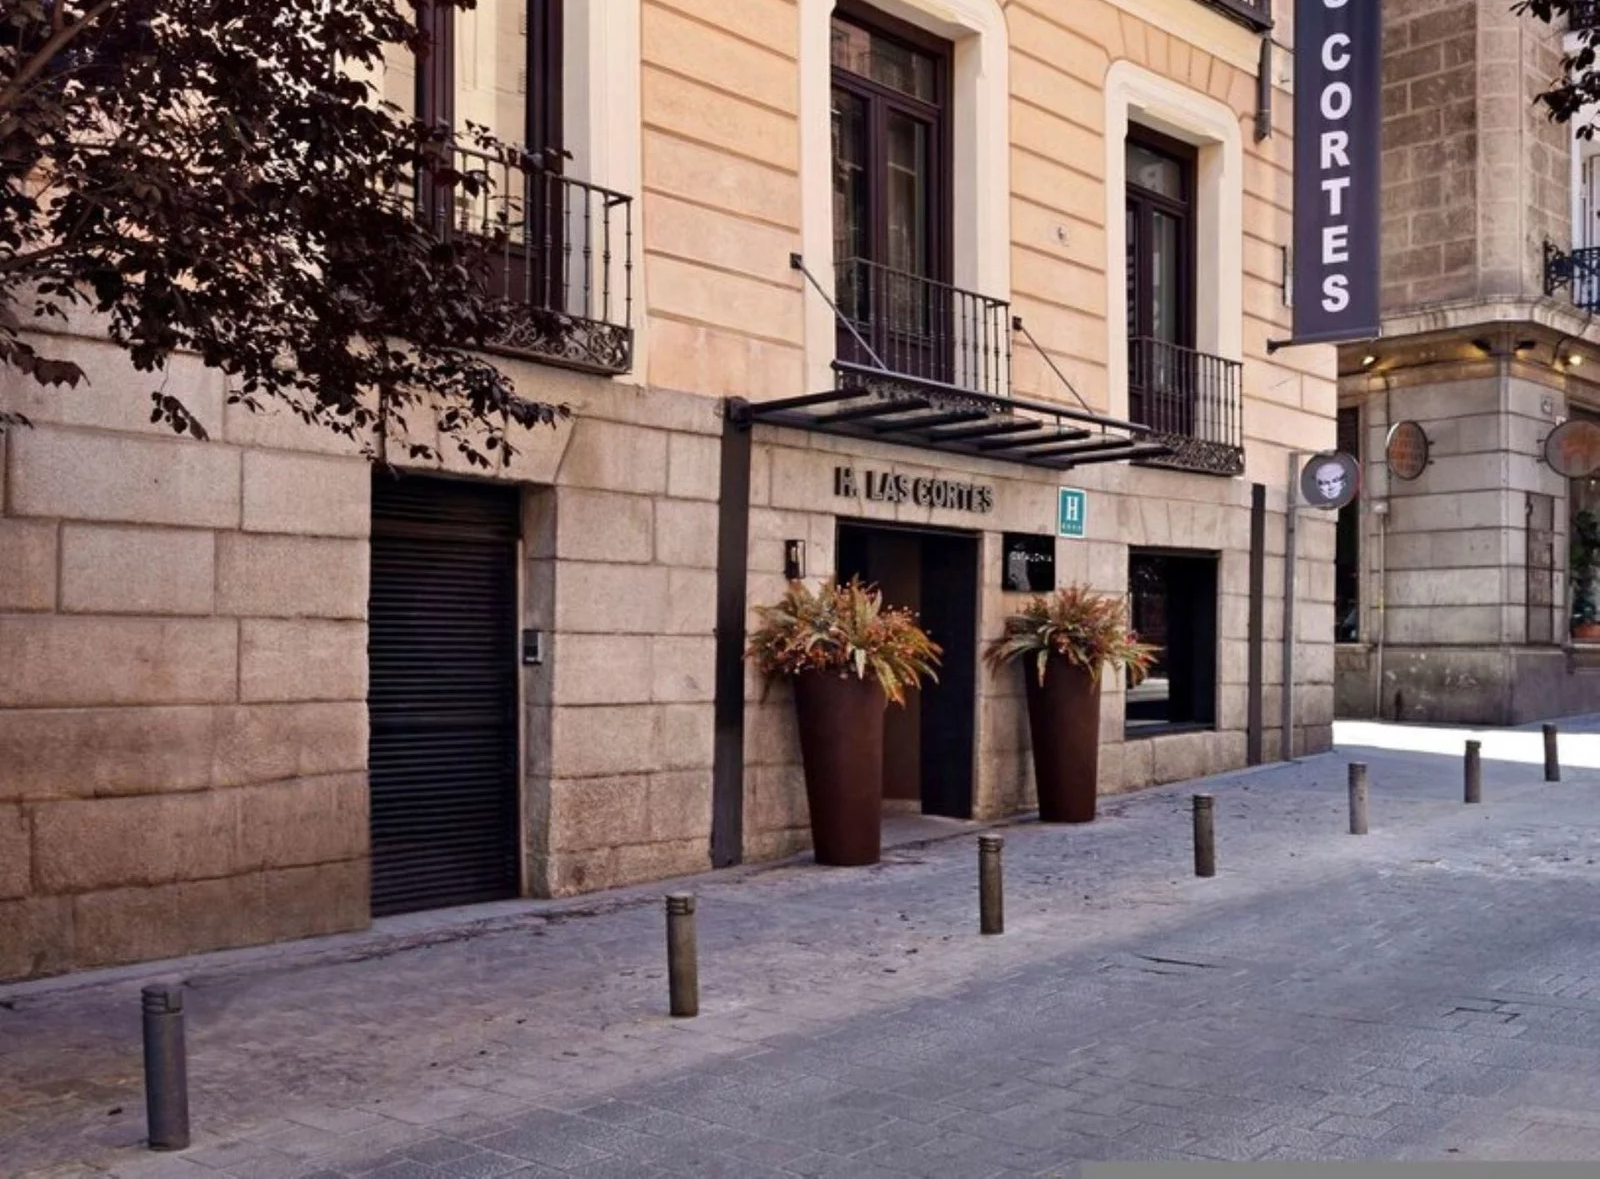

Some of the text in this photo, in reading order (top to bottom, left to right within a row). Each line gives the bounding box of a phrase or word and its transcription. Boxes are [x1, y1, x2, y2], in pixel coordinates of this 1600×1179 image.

[1320, 33, 1353, 314] CORTES
[866, 471, 909, 503] LAS
[913, 477, 993, 513] CORTES
[1066, 496, 1079, 521] H
